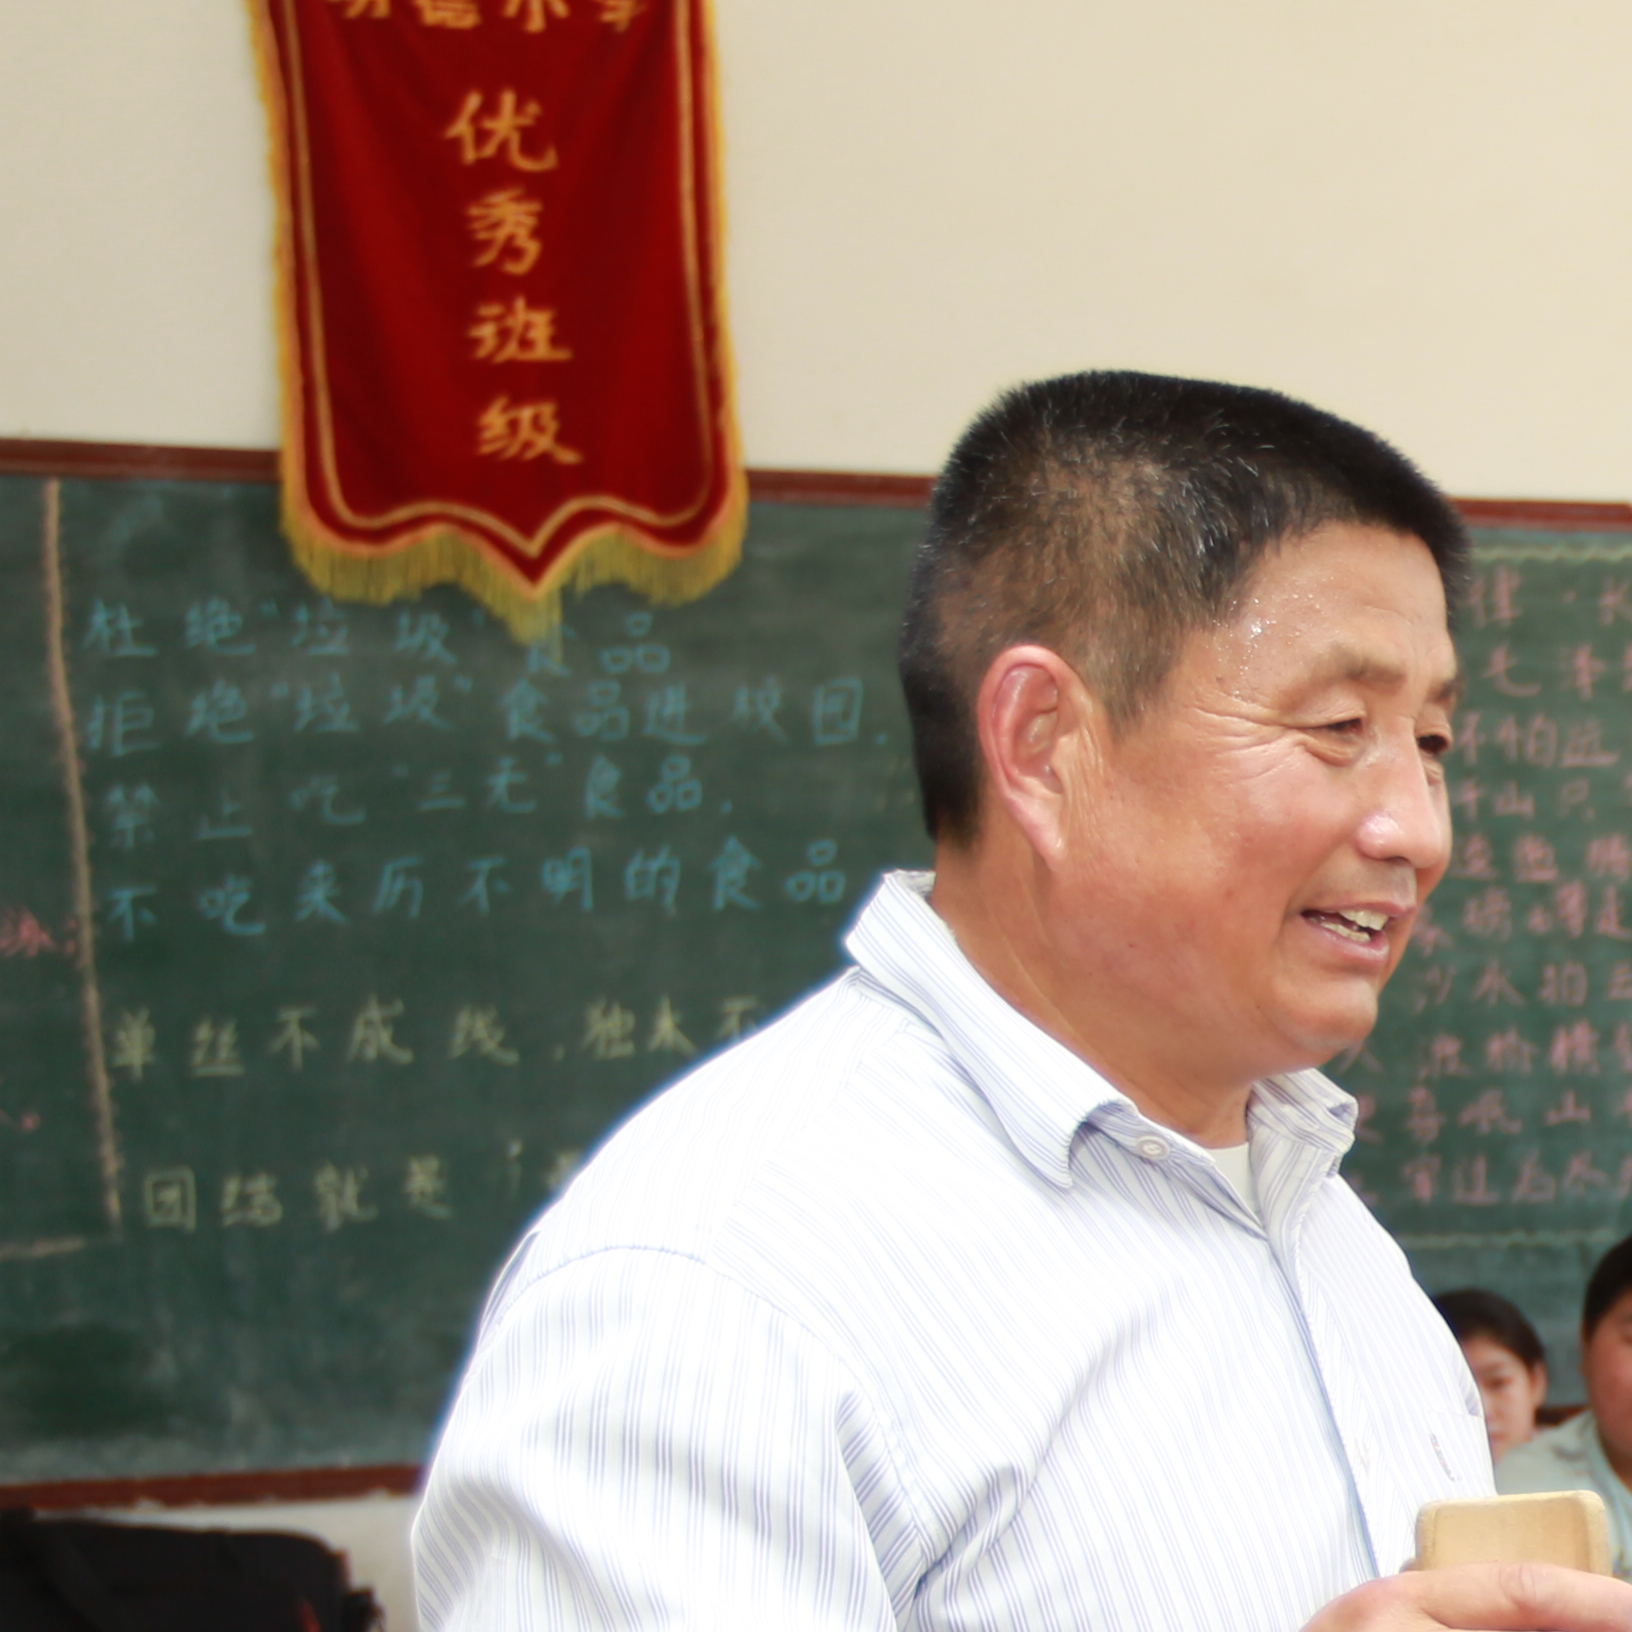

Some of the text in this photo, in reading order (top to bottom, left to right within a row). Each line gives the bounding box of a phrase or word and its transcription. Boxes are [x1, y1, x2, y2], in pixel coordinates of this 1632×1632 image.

[444, 88, 584, 466] 优秀班级
[103, 838, 849, 942] 不吃来历不明的食品
